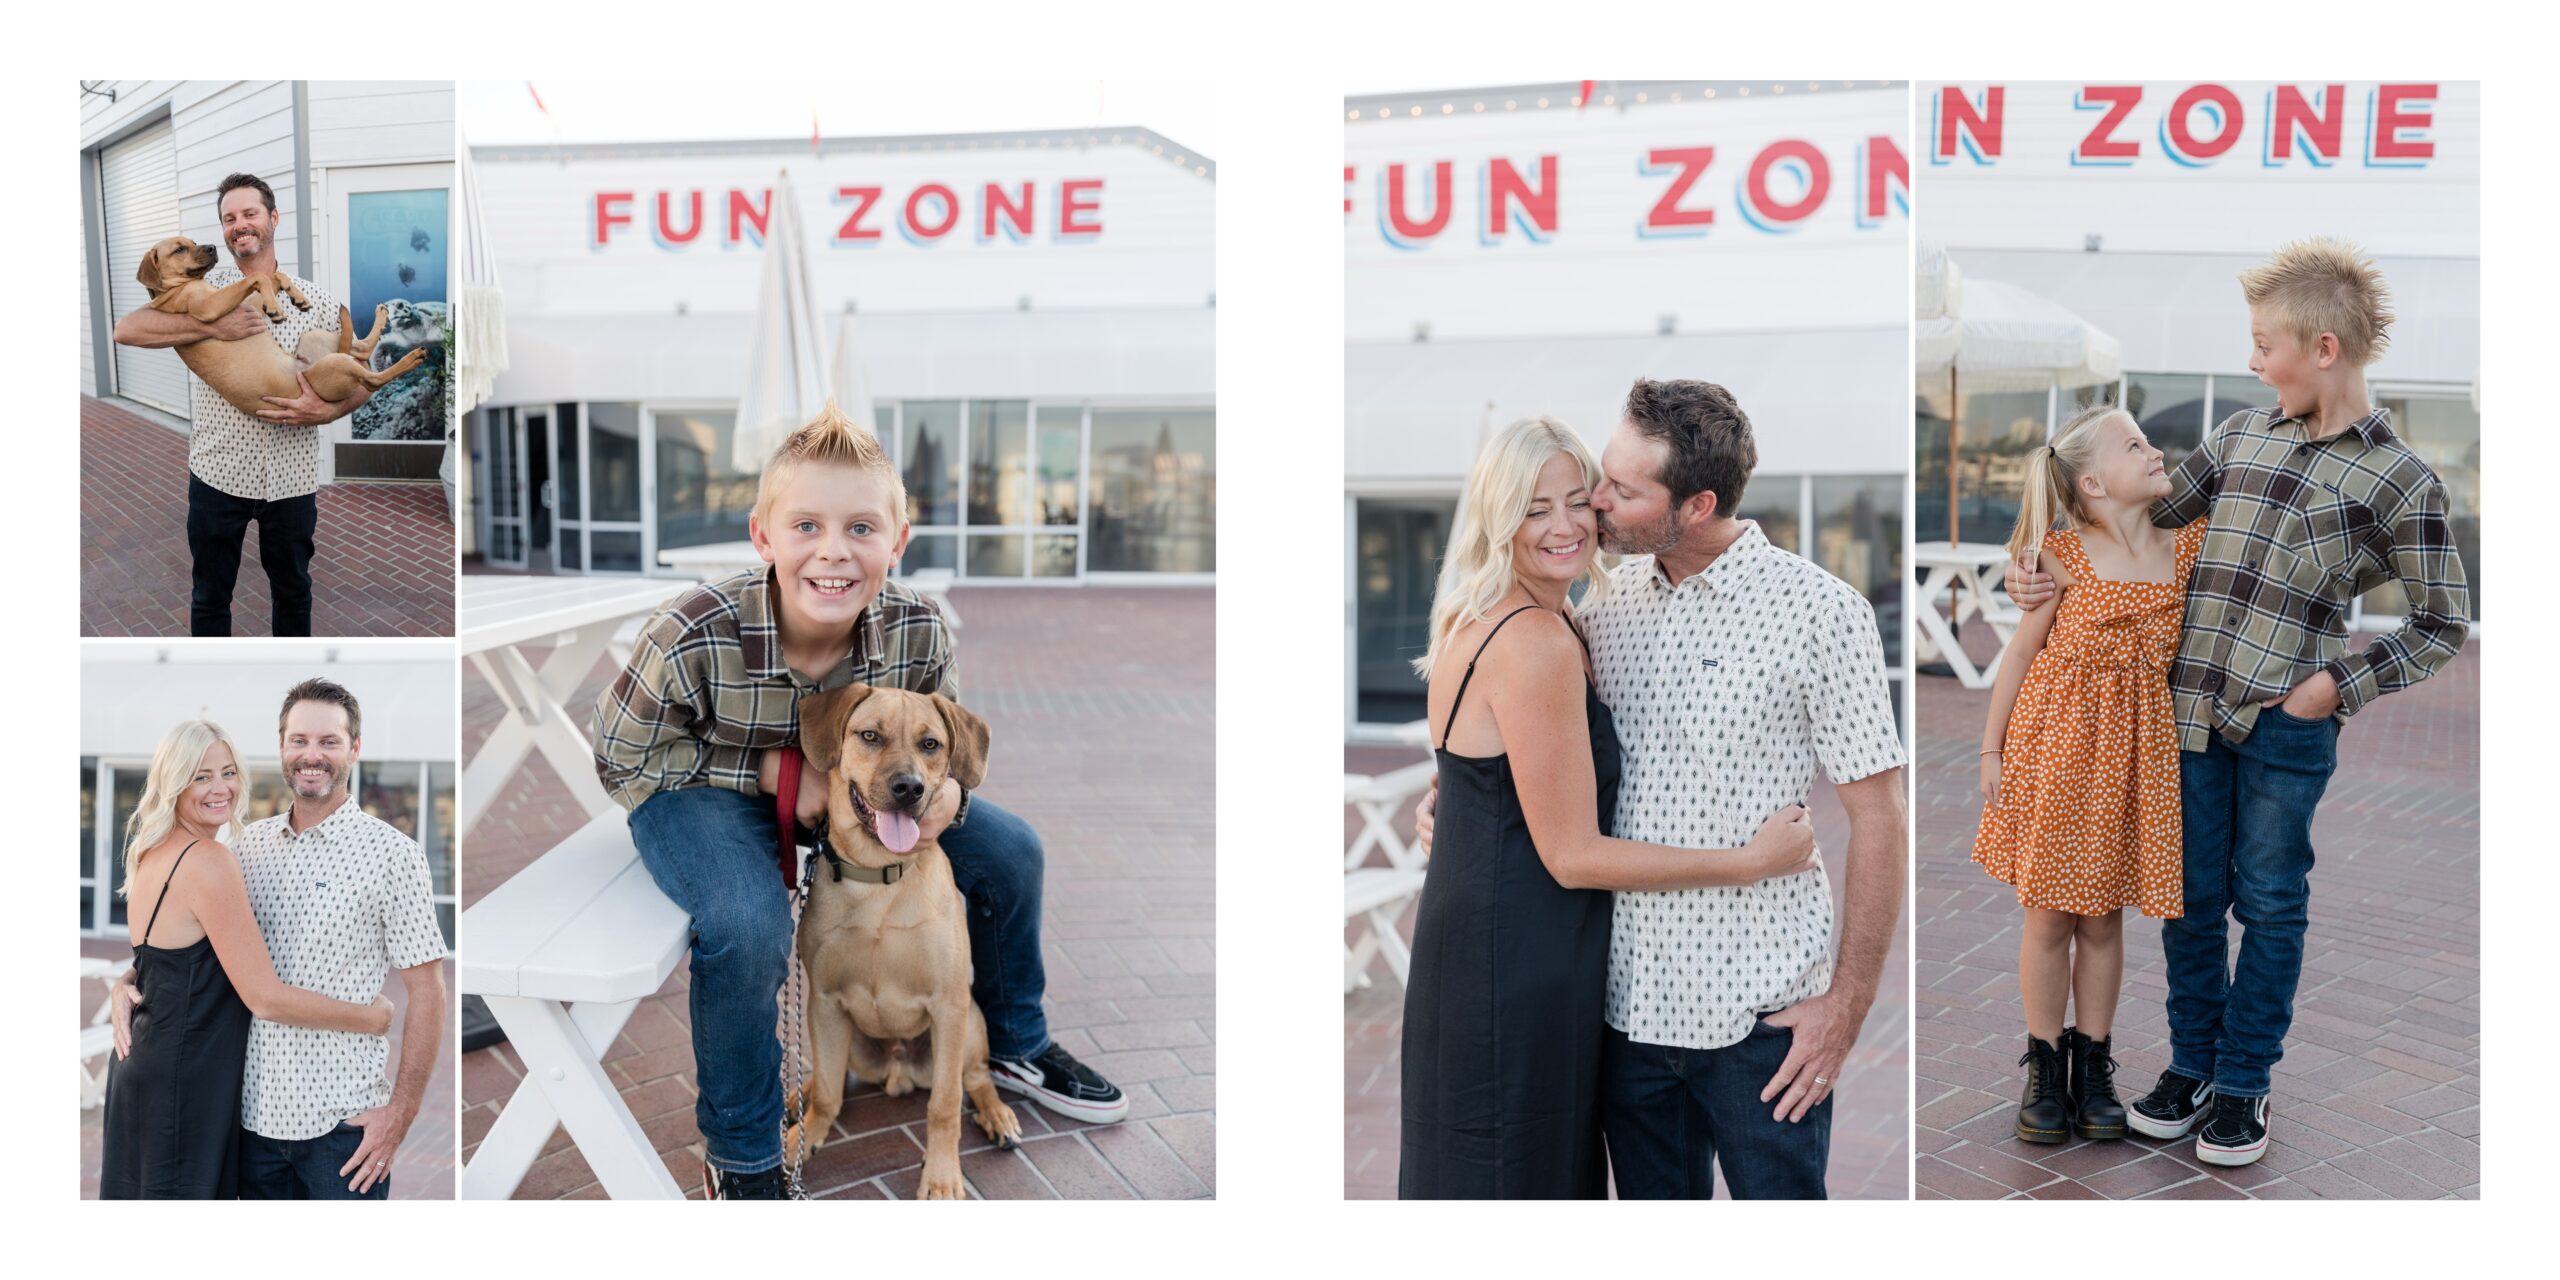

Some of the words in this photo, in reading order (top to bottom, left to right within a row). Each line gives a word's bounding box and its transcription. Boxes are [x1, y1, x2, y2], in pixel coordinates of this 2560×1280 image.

[2068, 82, 2439, 171] ZONE
[591, 188, 773, 252] FUN
[830, 179, 1105, 249] ZONE
[1344, 154, 1559, 252] UN
